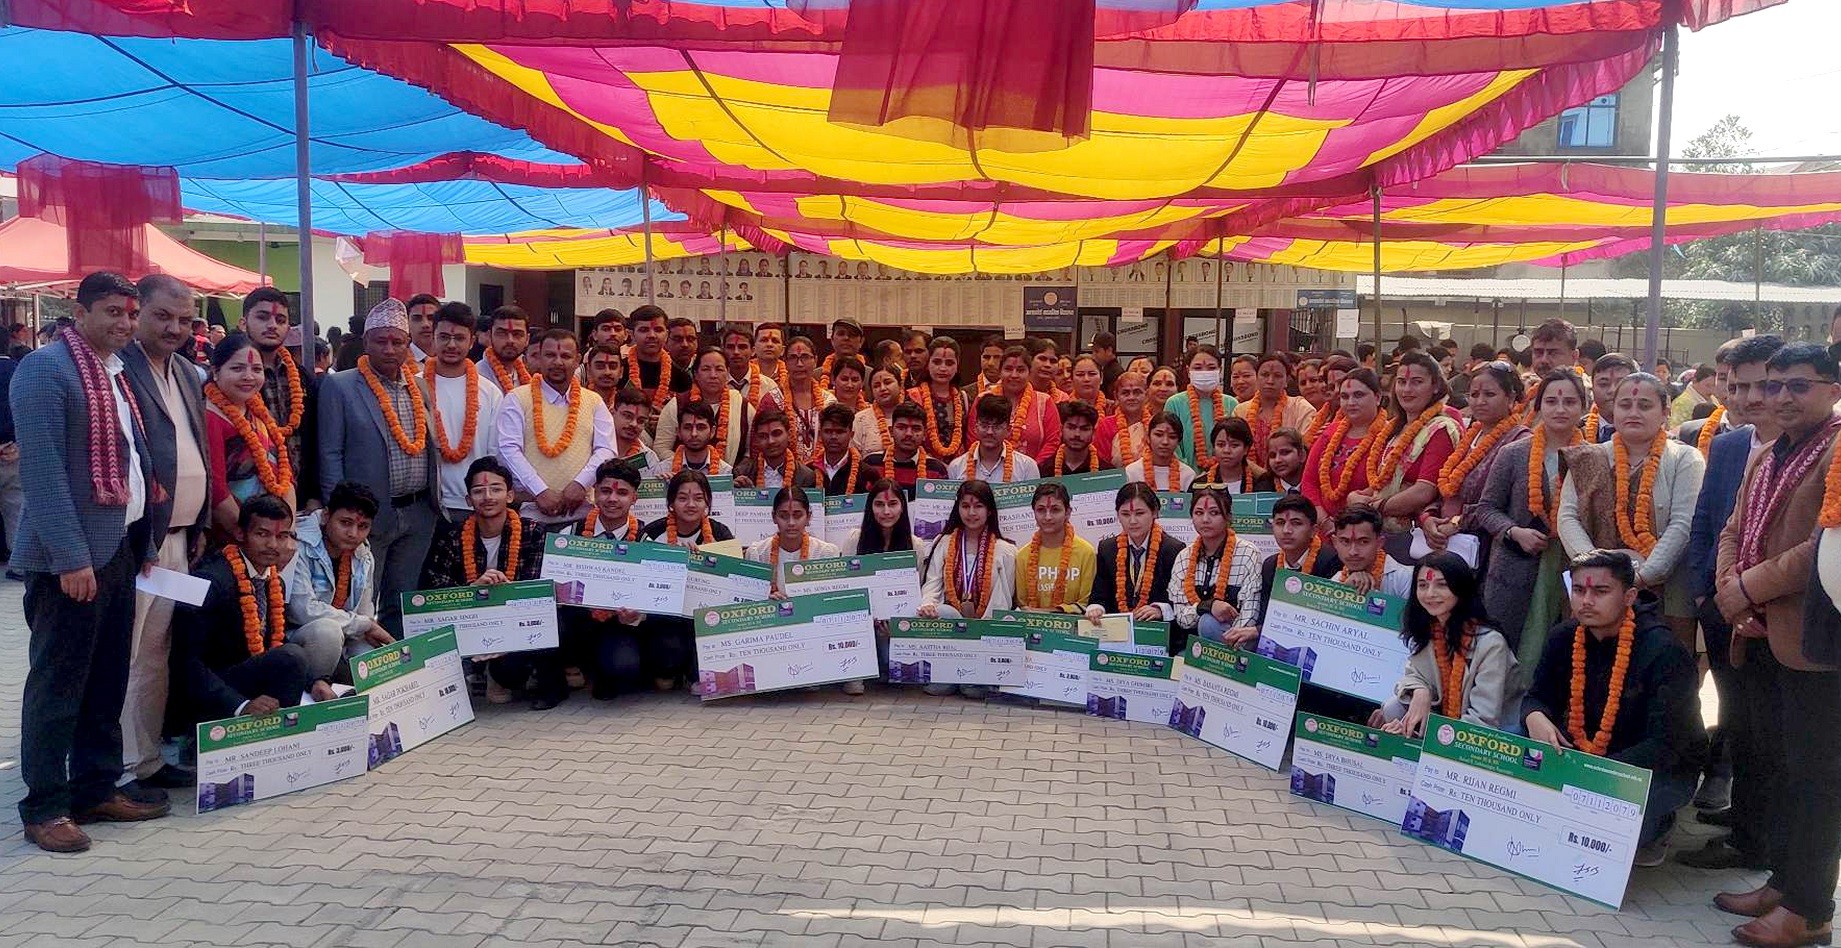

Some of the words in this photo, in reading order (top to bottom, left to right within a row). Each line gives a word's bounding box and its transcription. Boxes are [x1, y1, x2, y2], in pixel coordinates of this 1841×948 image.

[994, 485, 1037, 496] XFORD
[569, 540, 614, 550] OXFORD
[805, 561, 847, 571] OXFORD
[426, 592, 474, 602] OXFORD
[1303, 582, 1366, 604] OXFORD
[721, 605, 777, 620] OXFORD
[1310, 618, 1341, 632] SACHIN
[1342, 627, 1369, 639] ARYAL
[735, 636, 763, 645] GARIMA
[765, 631, 794, 642] PAUDEL
[1308, 632, 1322, 642] TEN
[1323, 635, 1361, 653] THOUSAND
[1362, 647, 1382, 658] ONLY
[753, 645, 786, 655] THOUSAND
[1202, 646, 1237, 663] OXFORD
[367, 650, 400, 669] OXFORD
[1109, 656, 1151, 666] OXFORD
[226, 716, 281, 733] OXFORD
[1318, 722, 1364, 739] OXFORD
[1456, 731, 1521, 756] OXFORD
[240, 748, 272, 760] SANDEEP
[1454, 741, 1492, 757] SECONDARY
[1492, 752, 1518, 765] SCHOOL
[1463, 775, 1487, 790] RIJAN
[1488, 783, 1517, 799] REGMI
[1461, 792, 1476, 803] TEN
[1477, 797, 1518, 816] THOUSAND
[1519, 810, 1542, 824] ONLY
[1568, 832, 1579, 844] Rs.
